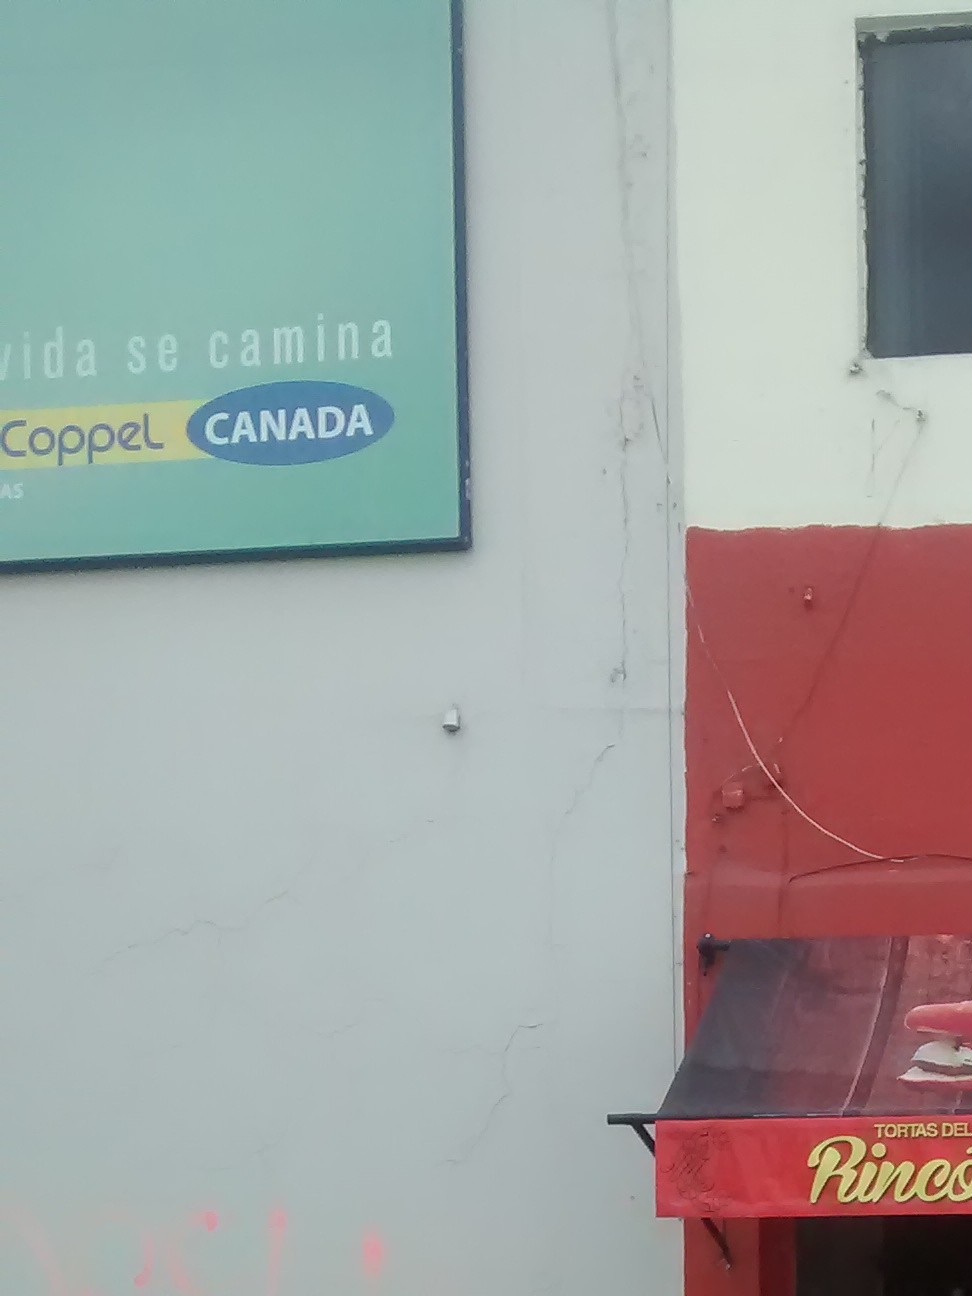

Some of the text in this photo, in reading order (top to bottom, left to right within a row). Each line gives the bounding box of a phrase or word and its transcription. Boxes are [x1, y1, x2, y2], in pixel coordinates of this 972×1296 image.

[127, 332, 179, 375] se
[208, 313, 394, 369] camina
[1, 413, 165, 466] Coppel
[204, 404, 375, 446] CANADA
[873, 1122, 939, 1139] TORTAS
